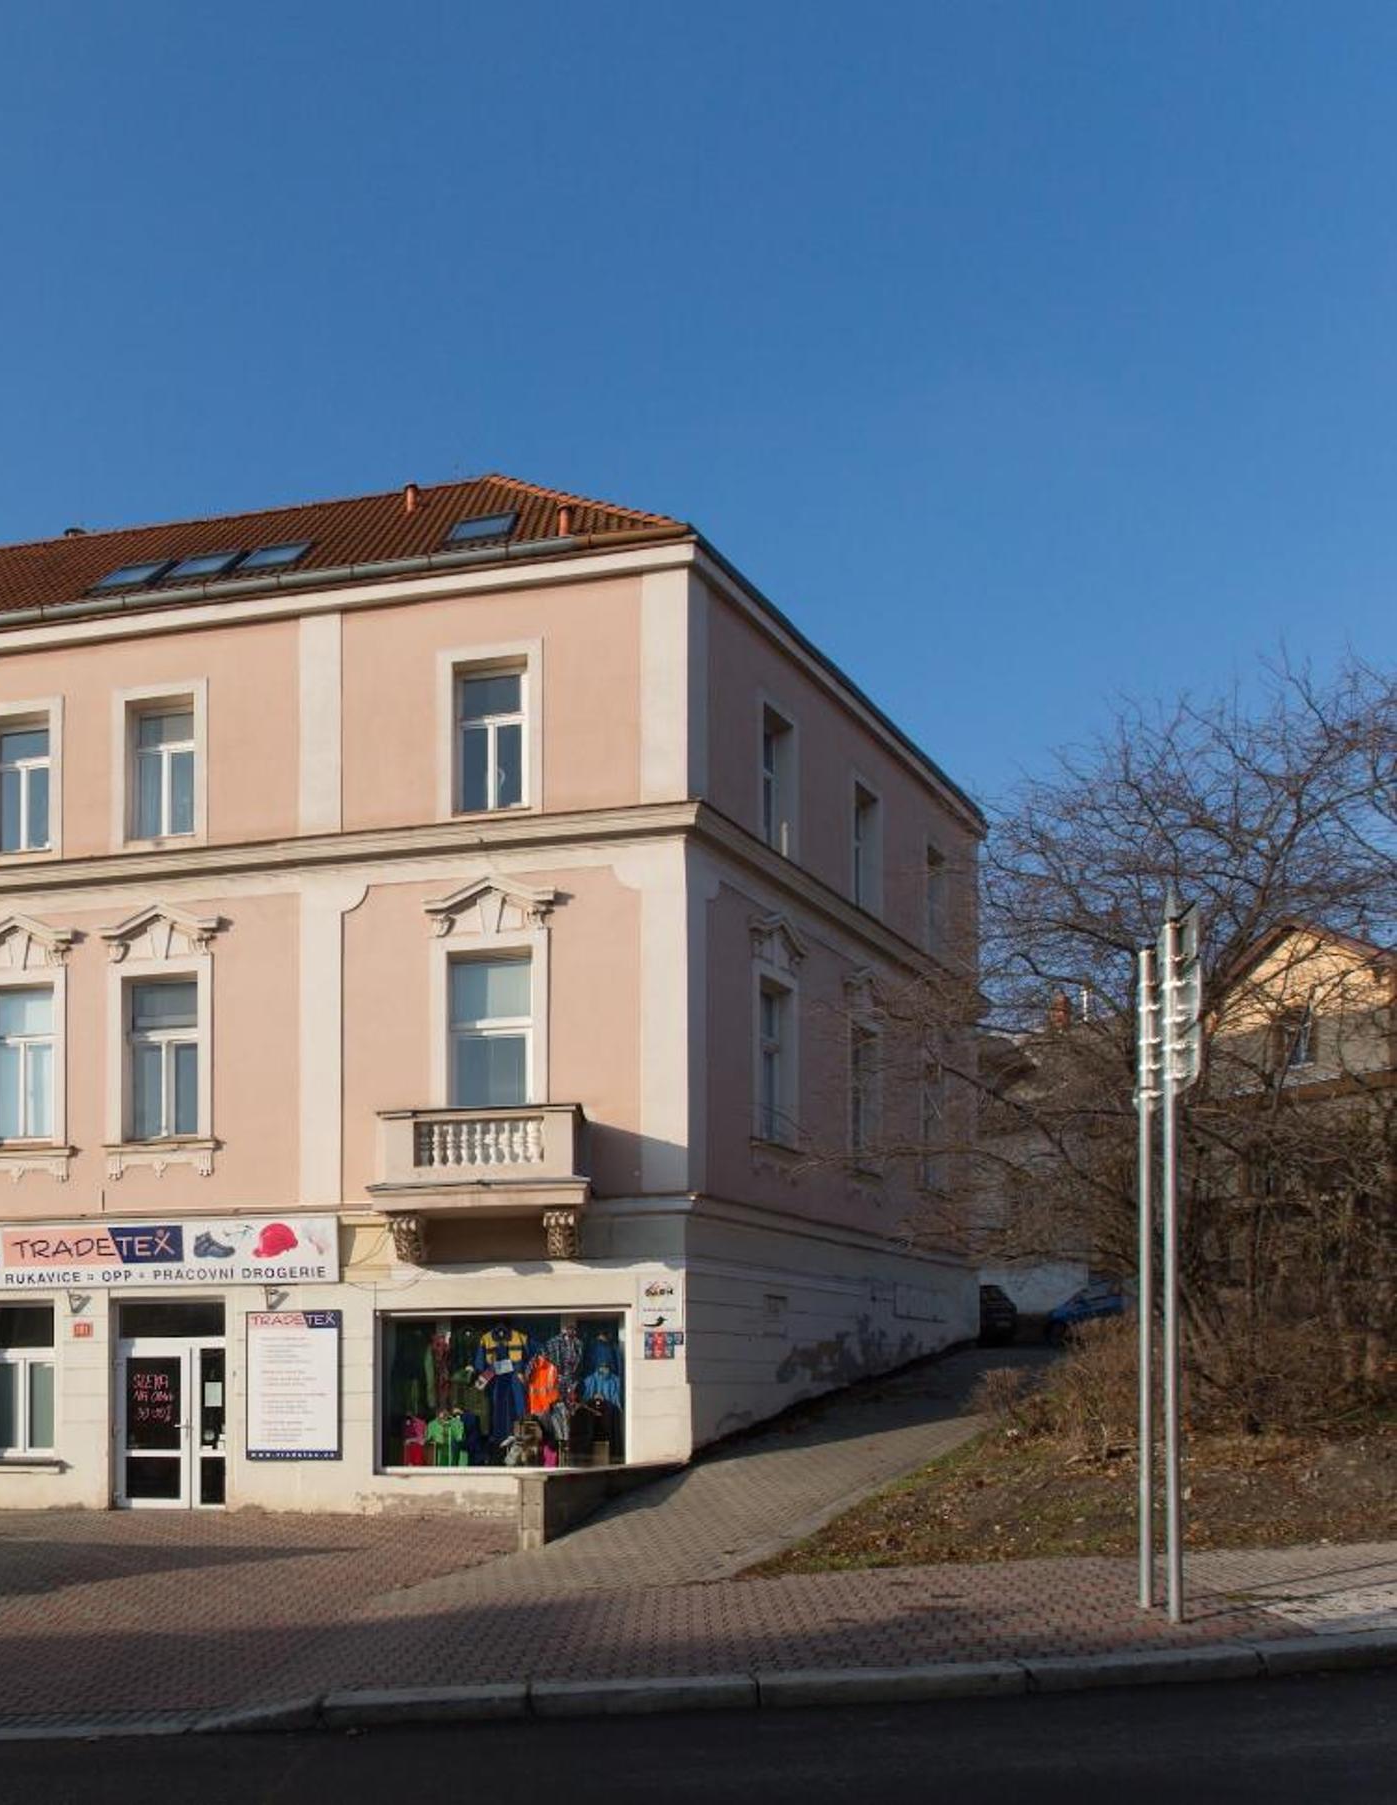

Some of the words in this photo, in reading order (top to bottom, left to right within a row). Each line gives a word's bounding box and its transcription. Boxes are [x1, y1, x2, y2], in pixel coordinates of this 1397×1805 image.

[11, 1230, 175, 1258] TRADETEX
[5, 1271, 81, 1285] RUKAVICE
[153, 1267, 234, 1281] PRACOVNÍ
[241, 1266, 327, 1279] DROGERIE
